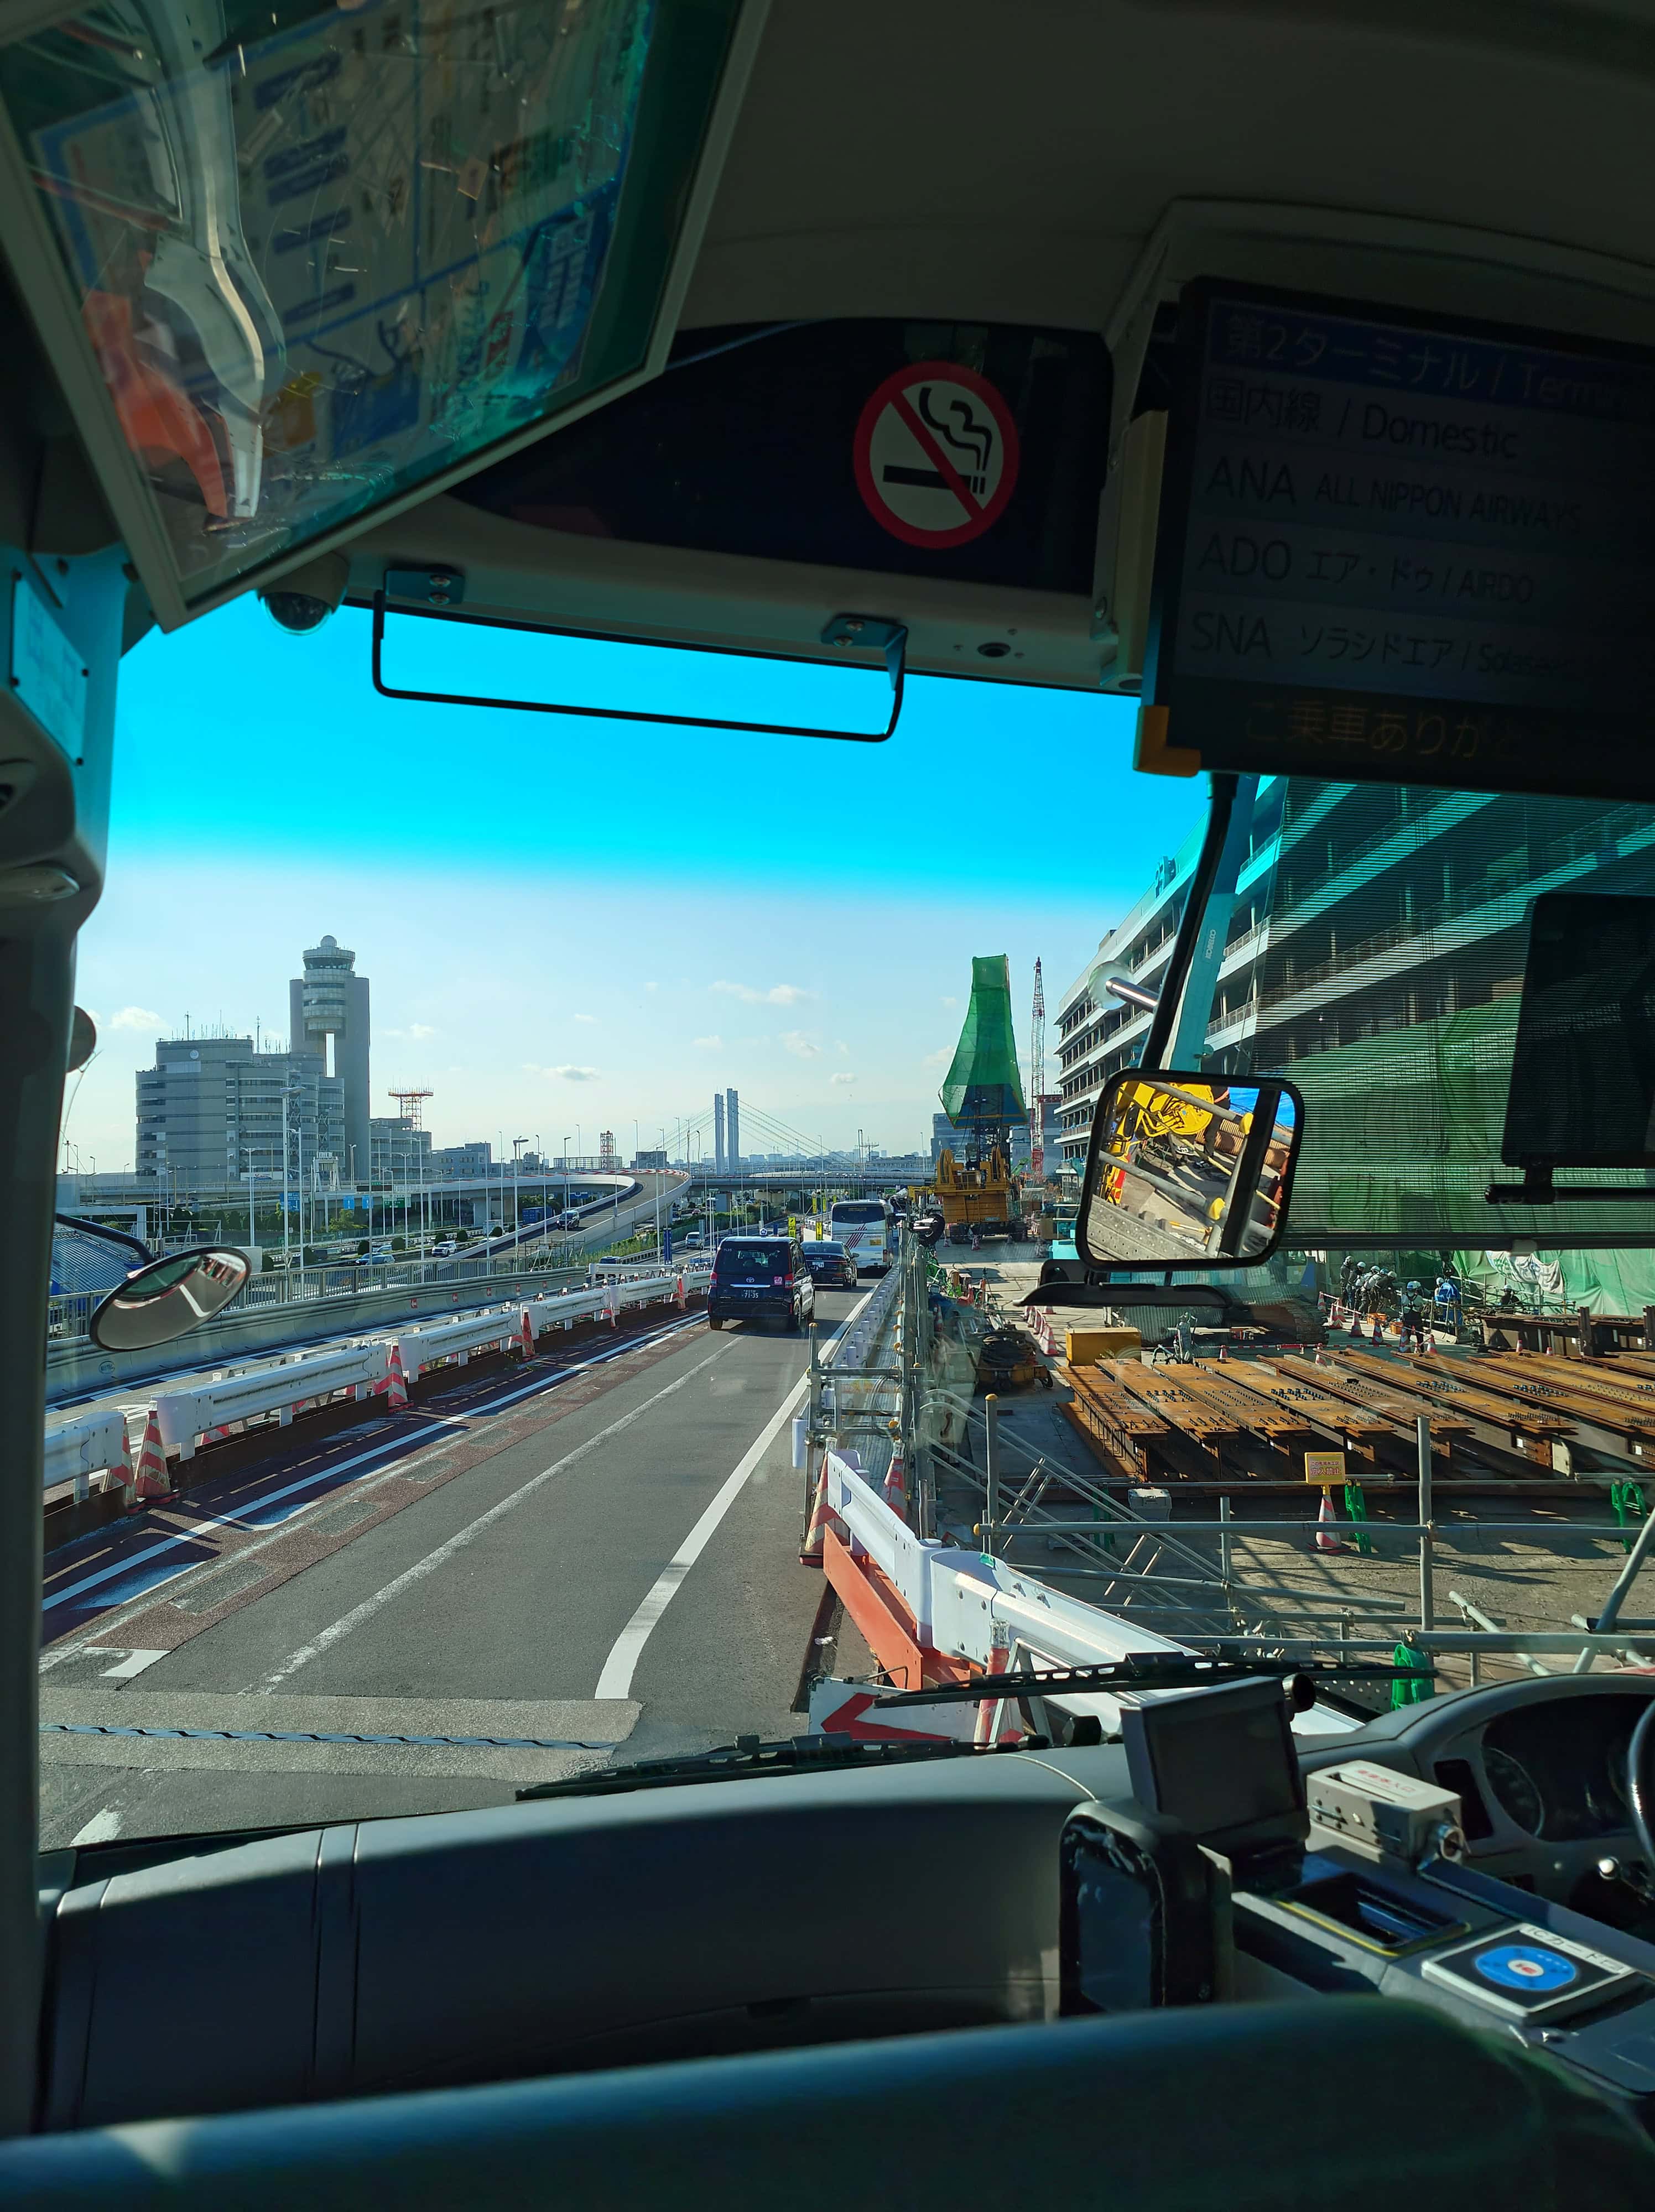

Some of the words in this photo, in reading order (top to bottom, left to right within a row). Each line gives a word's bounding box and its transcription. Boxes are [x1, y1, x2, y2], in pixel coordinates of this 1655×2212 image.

[1226, 314, 1481, 390] 第2ターミナル
[1207, 377, 1323, 434] 国内線
[1361, 402, 1518, 460] Domestic
[1205, 456, 1297, 507] ANA
[1314, 473, 1361, 508] ALL
[1370, 479, 1463, 520] NIPPON
[1469, 491, 1582, 534] AIRWAYS
[1196, 532, 1293, 582] ADO
[1190, 611, 1272, 659] SNA
[1300, 624, 1454, 671] ソラシドエア
[1310, 1467, 1341, 1476] 立入禁止
